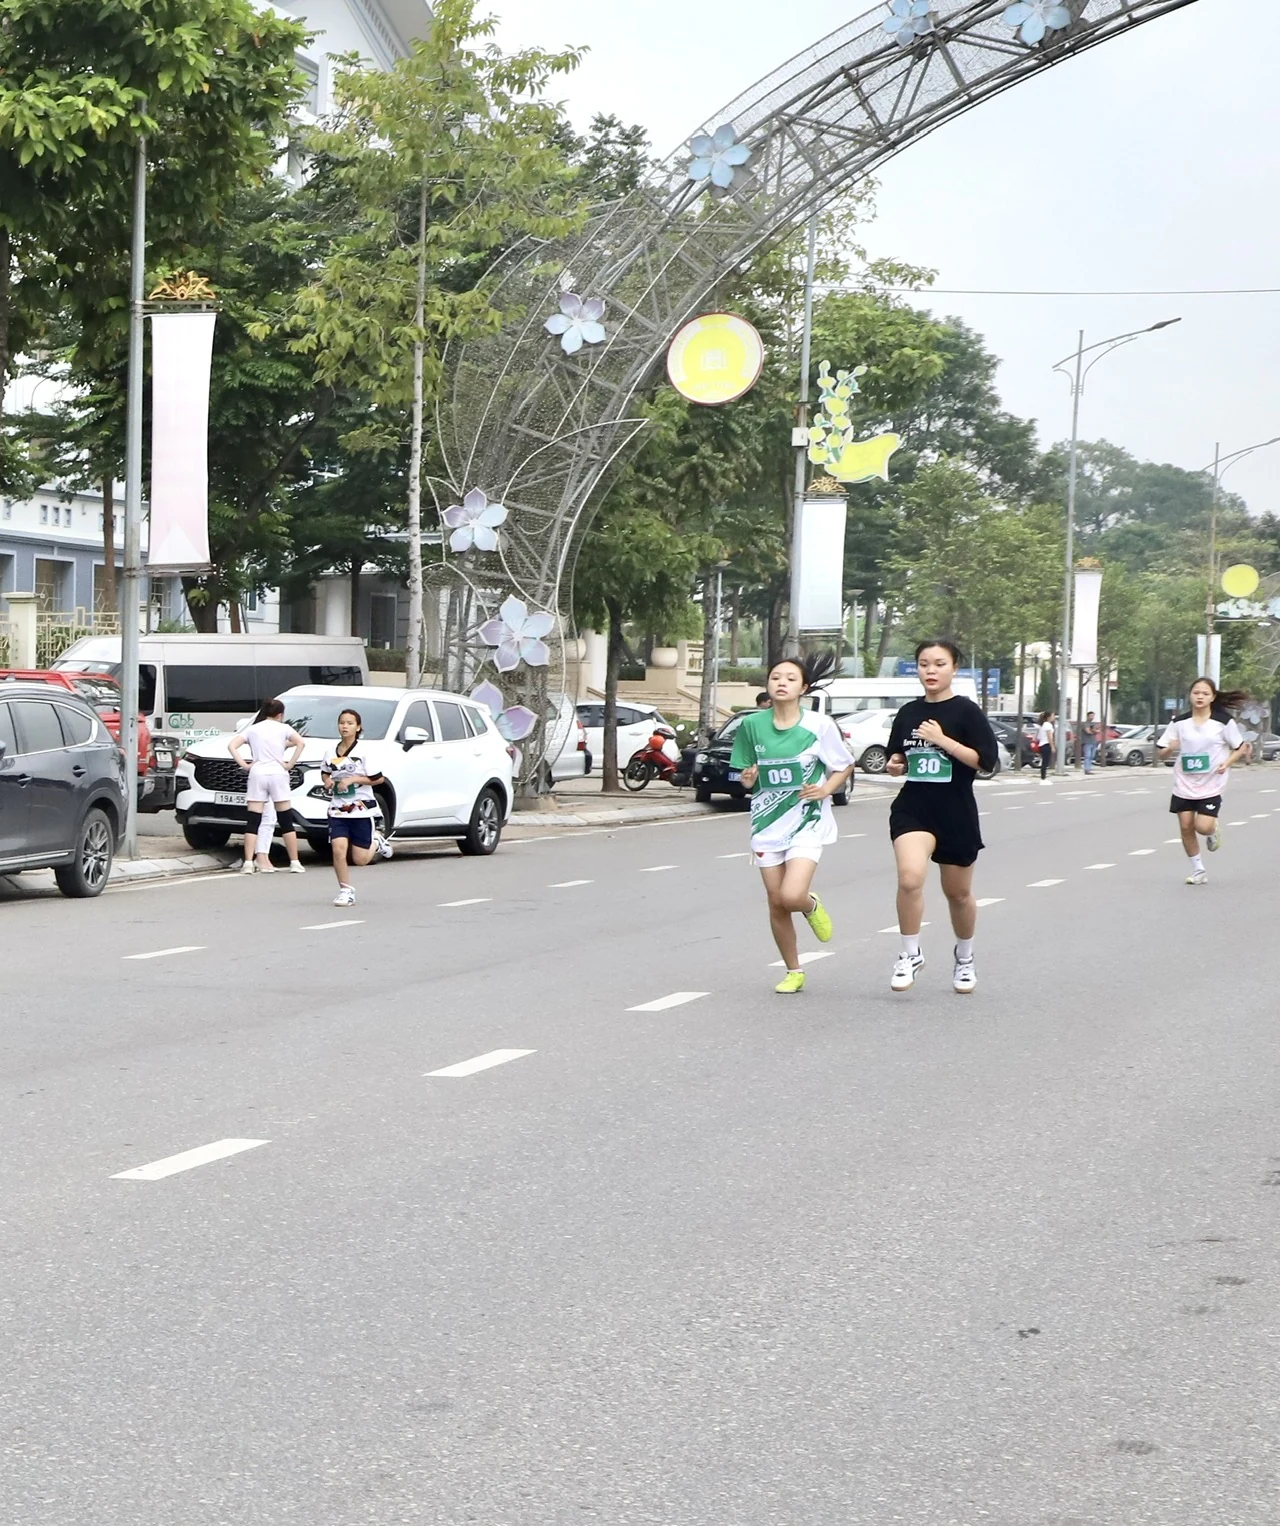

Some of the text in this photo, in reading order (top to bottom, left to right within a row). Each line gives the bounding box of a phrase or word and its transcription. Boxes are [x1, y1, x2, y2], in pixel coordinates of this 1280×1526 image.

[916, 757, 941, 775] 30
[1187, 758, 1204, 769] 84
[767, 767, 793, 785] 09
